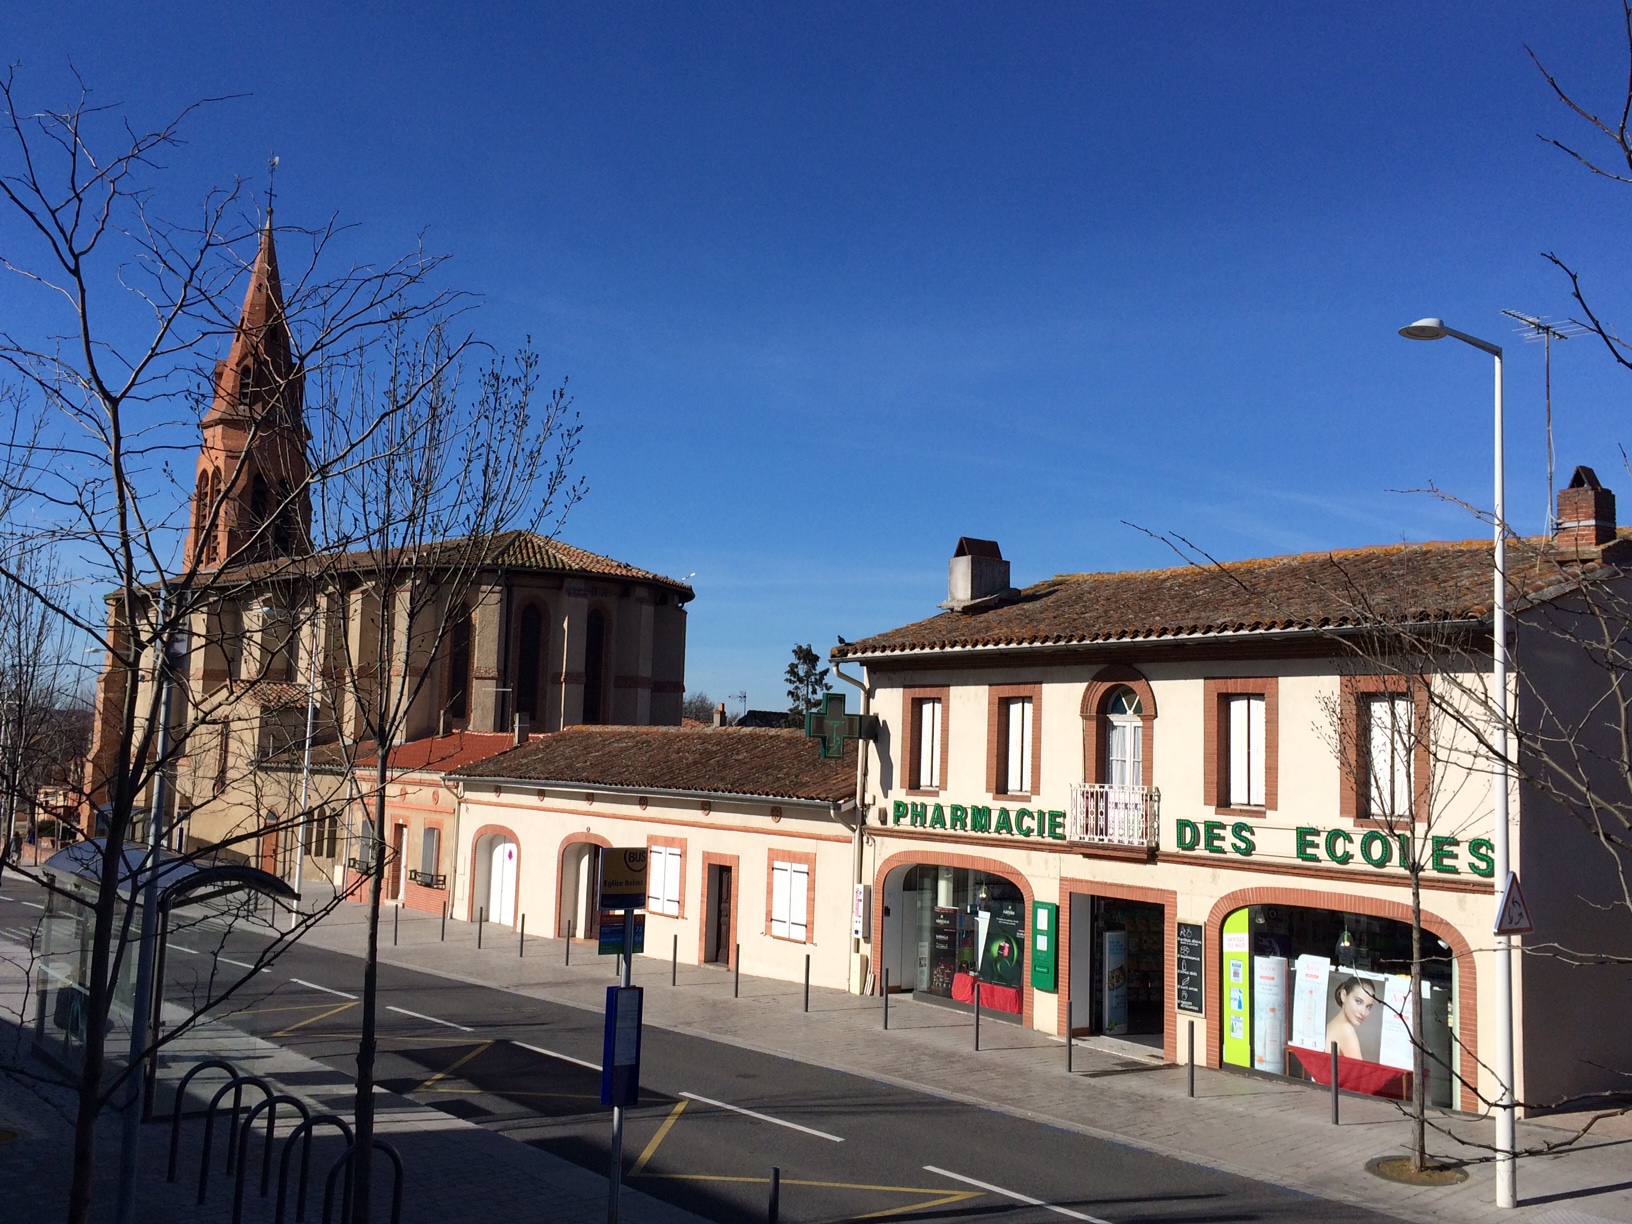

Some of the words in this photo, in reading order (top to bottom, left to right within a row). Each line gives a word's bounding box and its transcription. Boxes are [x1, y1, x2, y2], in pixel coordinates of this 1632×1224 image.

[893, 800, 1065, 839] PHARMACIE
[1176, 818, 1253, 855] DES
[628, 851, 646, 863] BUS
